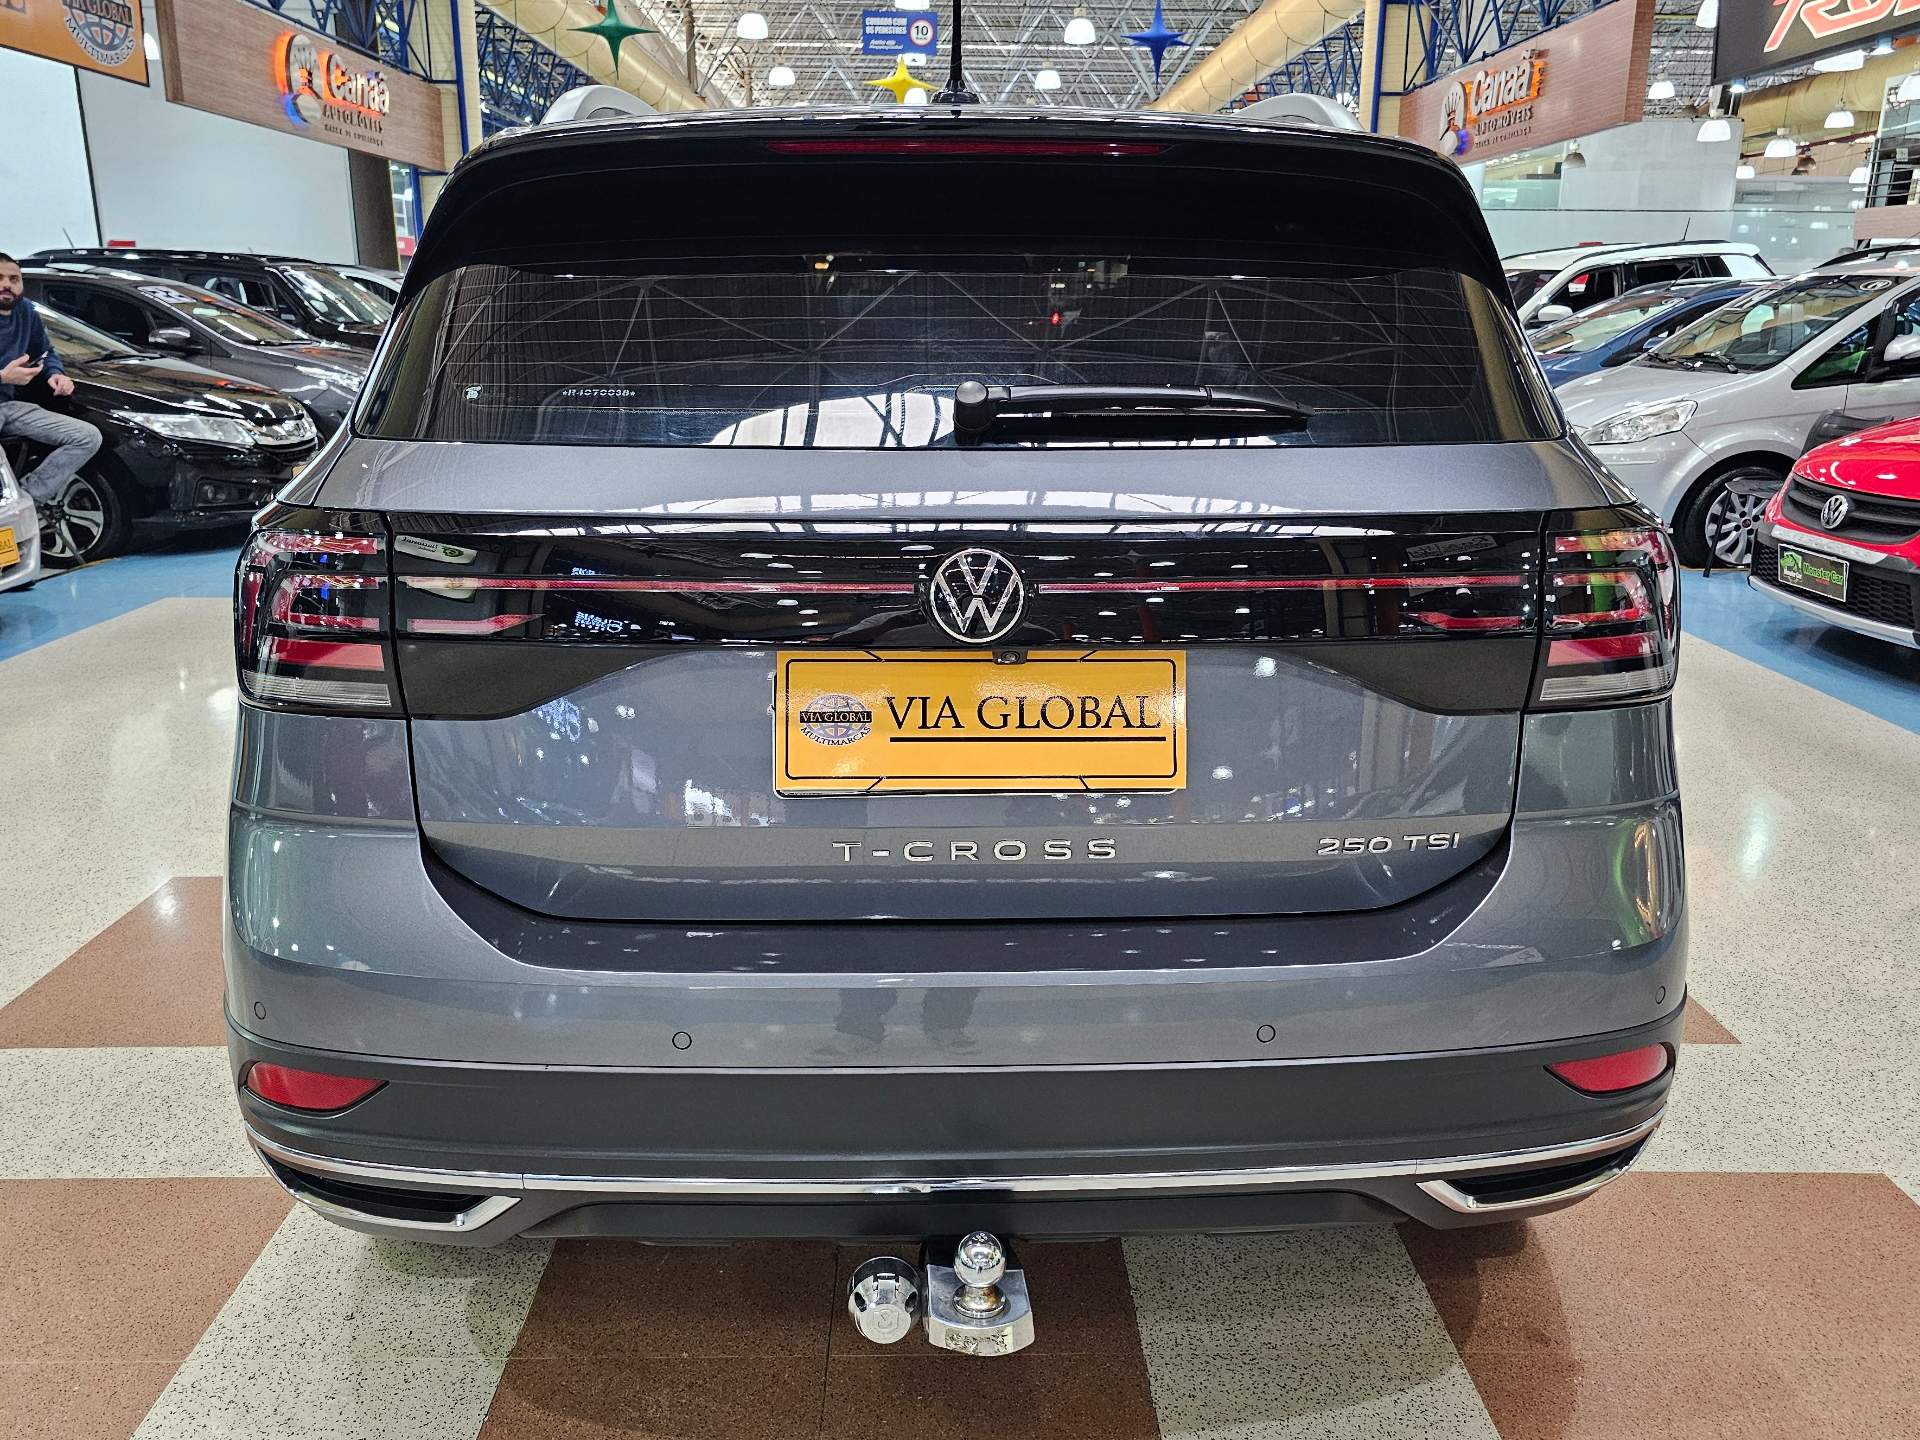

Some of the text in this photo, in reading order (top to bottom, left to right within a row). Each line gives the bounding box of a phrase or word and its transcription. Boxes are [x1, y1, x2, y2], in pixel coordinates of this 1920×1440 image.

[915, 25, 929, 36] 10
[1803, 562, 1831, 581] Monster
[1830, 570, 1845, 585] Car
[801, 712, 871, 722] VIA GLOBAL
[884, 695, 1162, 730] VIA GLOBAL
[800, 726, 872, 746] MULTIMARCAS
[831, 838, 1118, 862] T-CROSS
[1316, 832, 1461, 856] 250 TSI
